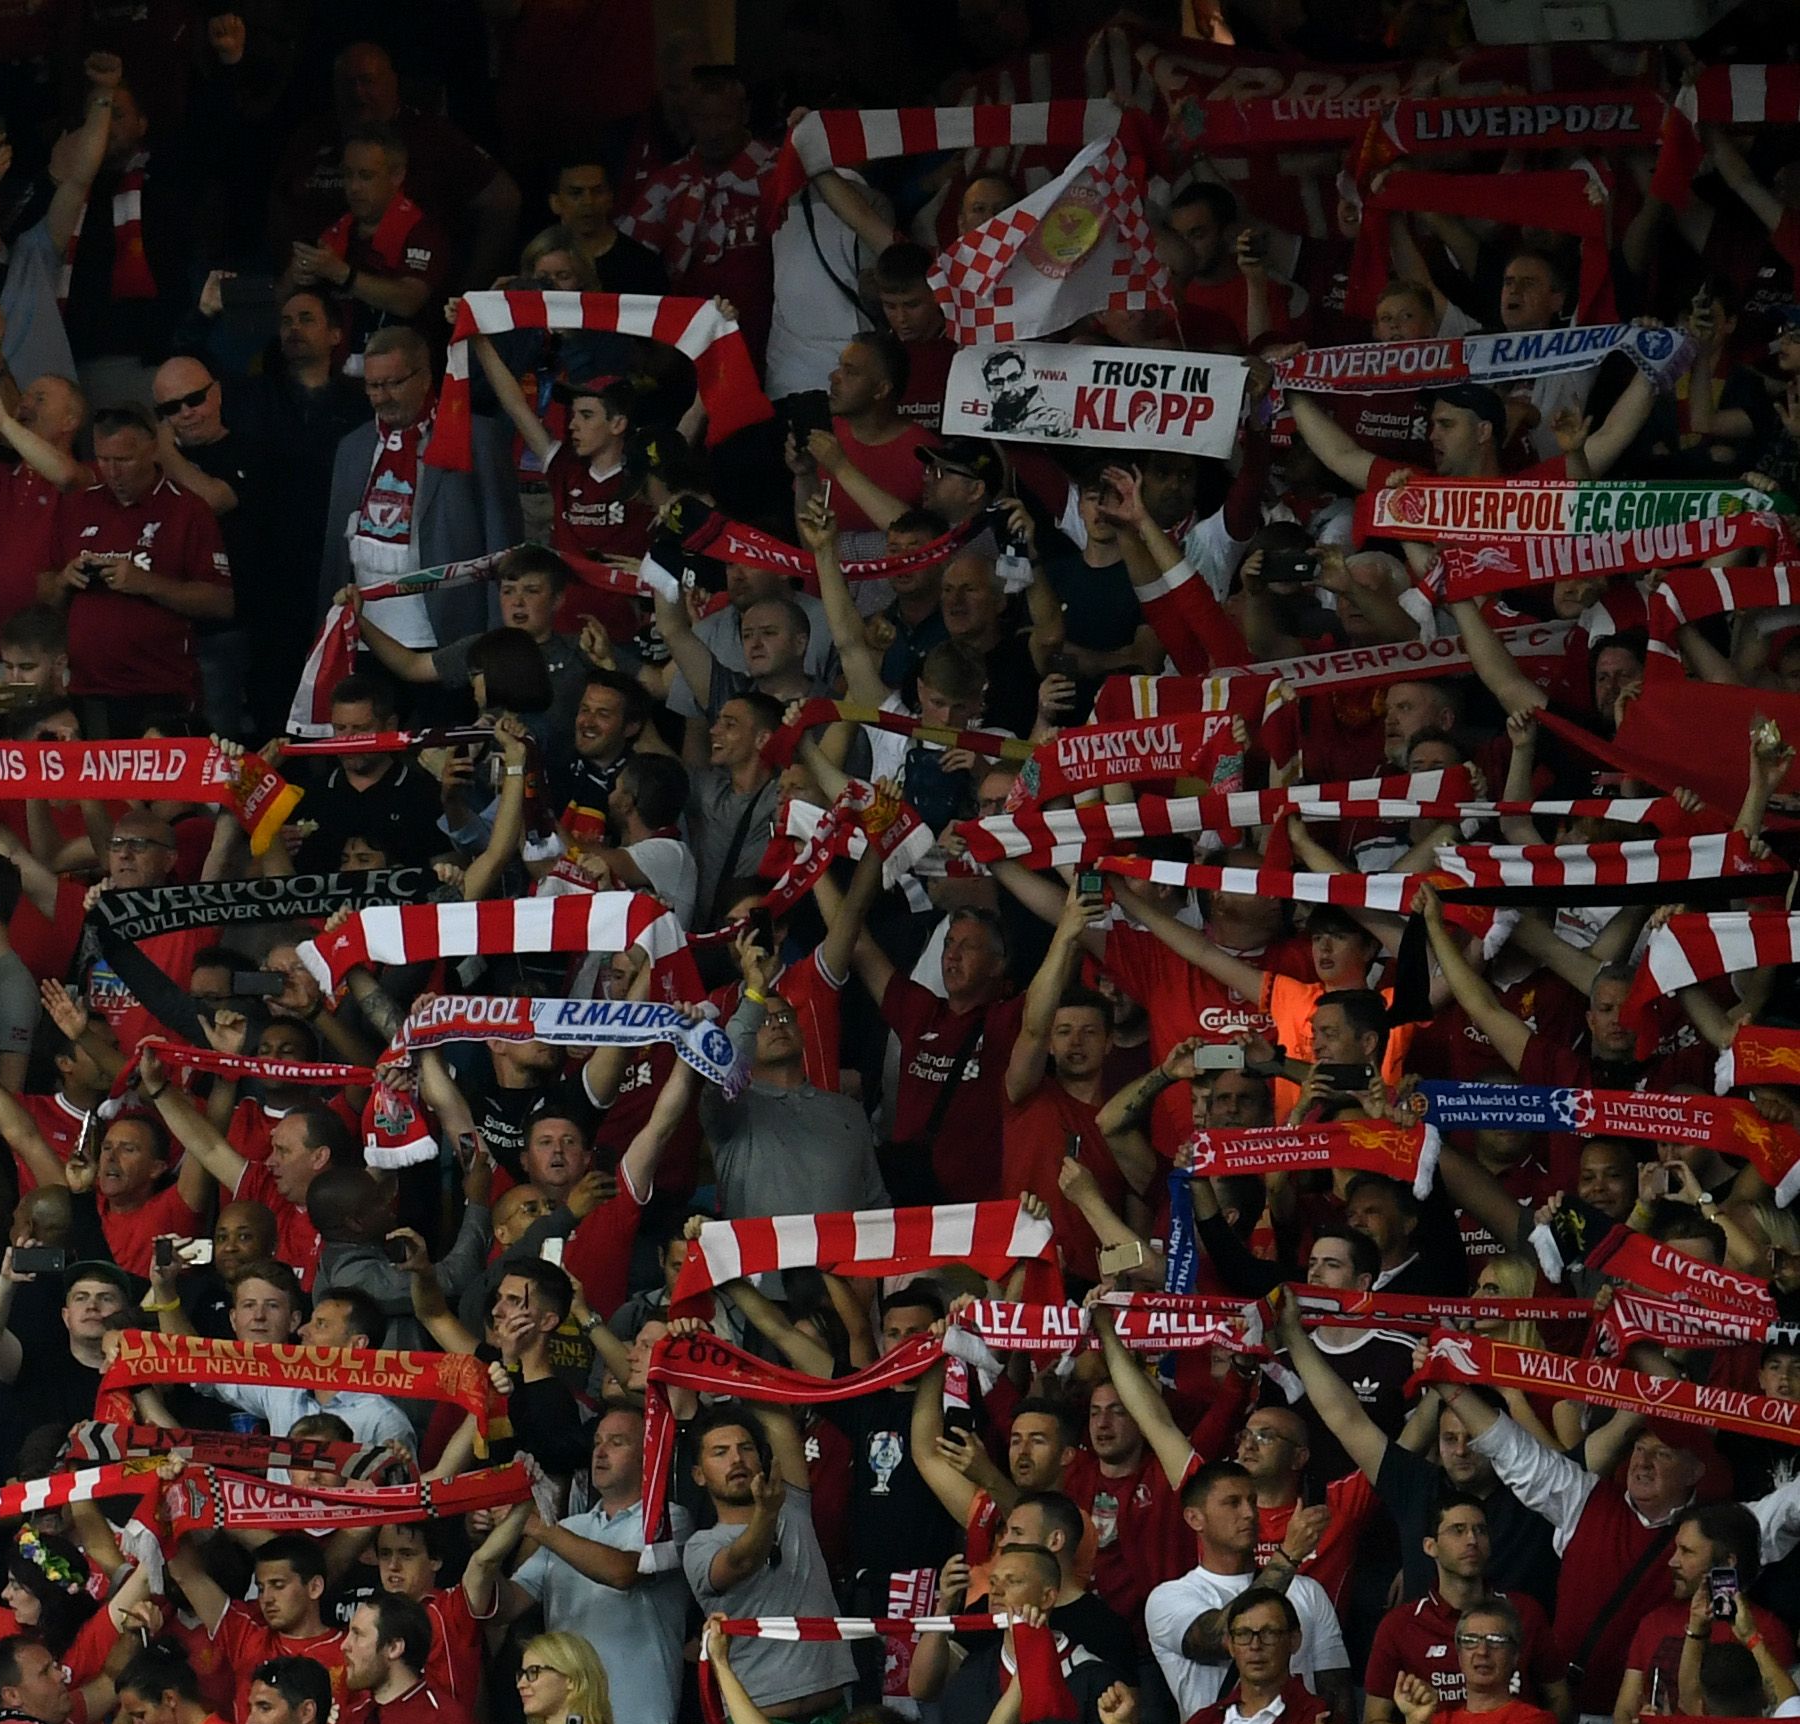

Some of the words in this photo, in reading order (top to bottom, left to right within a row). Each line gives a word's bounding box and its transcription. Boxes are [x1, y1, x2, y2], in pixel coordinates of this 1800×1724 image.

[1416, 103, 1639, 139] LIVERPOOL
[1032, 368, 1069, 382] YNWA
[1091, 360, 1176, 389] TRUST
[1181, 368, 1210, 393] IN
[1306, 343, 1454, 380] LIVERPOOL
[1072, 386, 1214, 437] KLOPP
[1428, 490, 1565, 531] LIVERPOOL
[41, 748, 64, 780] IS
[78, 747, 188, 781] ANFIELD
[106, 876, 360, 928] LIVERPOOL
[367, 868, 423, 899] FC
[1437, 1093, 1472, 1107] Real
[1473, 1093, 1517, 1108] Madrid
[1519, 1094, 1543, 1108] C.F.
[1439, 1109, 1478, 1123] FINAL
[1480, 1111, 1512, 1123] KYIV
[1514, 1111, 1546, 1124] 2018
[1602, 1101, 1686, 1122] LIVERPOOL
[1692, 1110, 1714, 1126] FC
[1520, 1351, 1579, 1383] WALK
[1588, 1363, 1621, 1390] ON
[1694, 1384, 1754, 1415] WALK
[1760, 1400, 1796, 1427] ON
